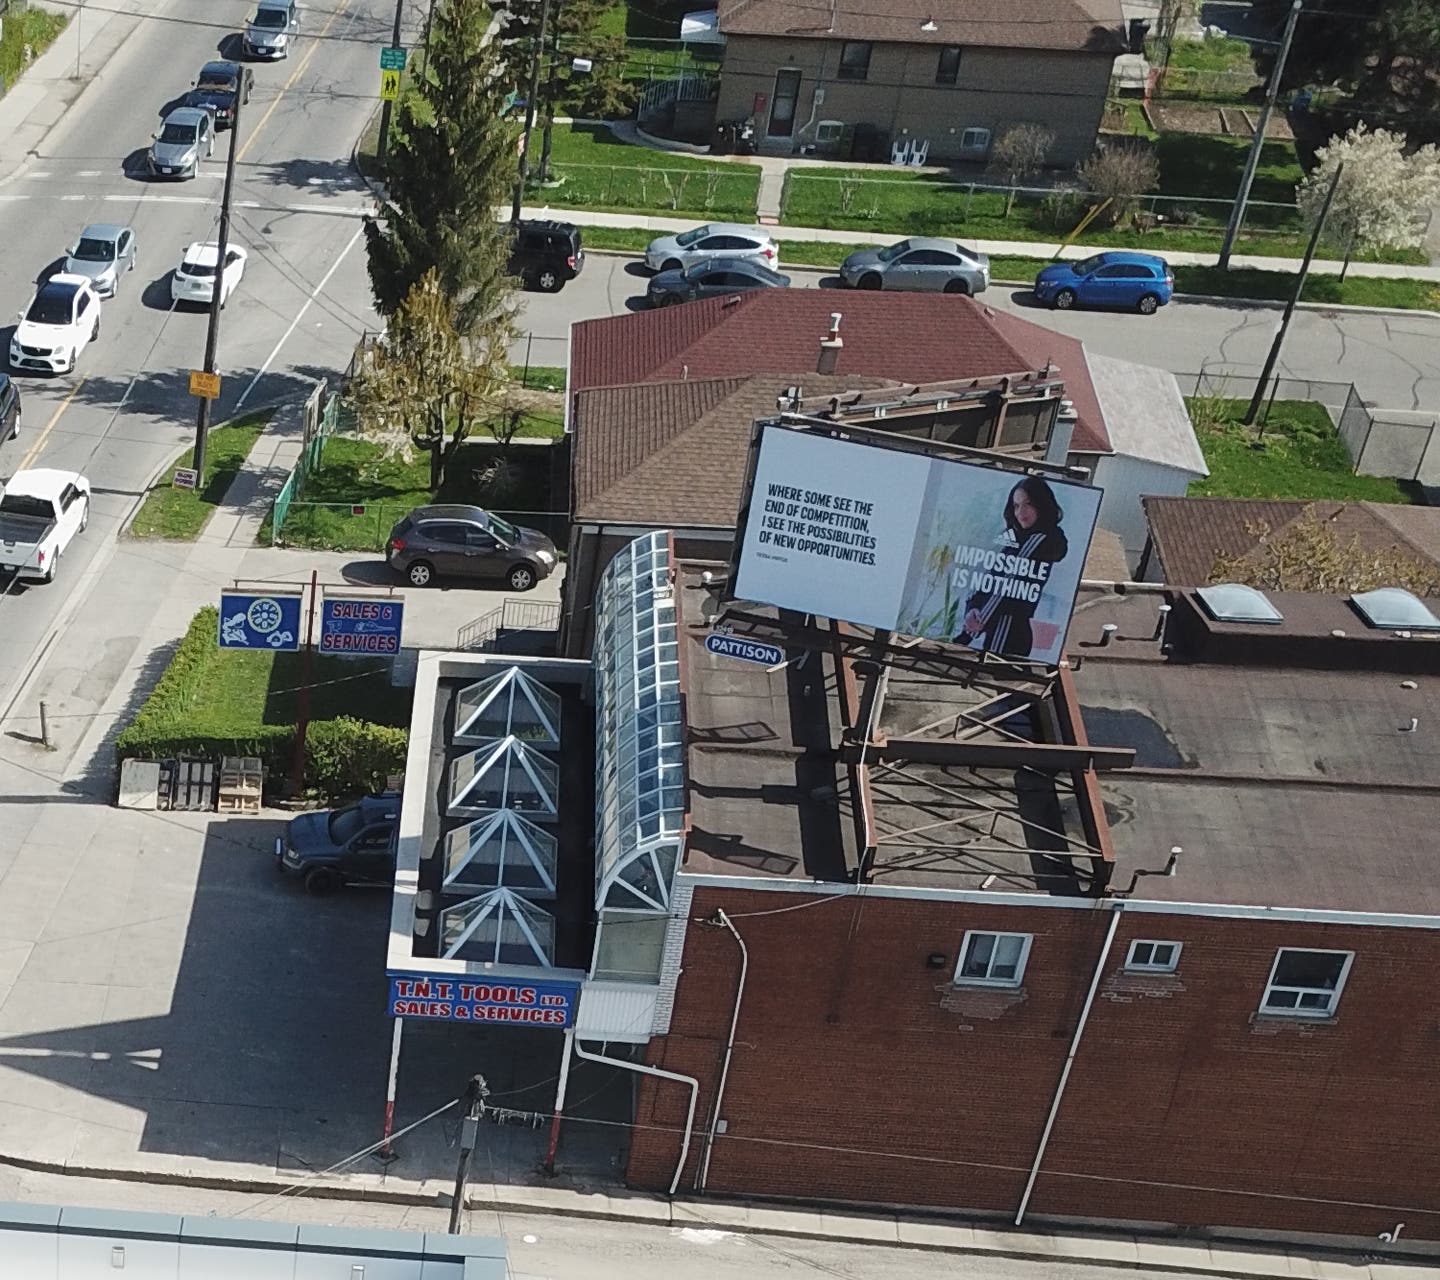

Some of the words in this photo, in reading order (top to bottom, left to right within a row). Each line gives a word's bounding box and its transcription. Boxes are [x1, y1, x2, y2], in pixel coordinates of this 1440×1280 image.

[768, 483, 803, 501] WHERE
[804, 490, 832, 508] SOME
[833, 496, 854, 512] SEE
[854, 500, 874, 516] THE
[761, 515, 767, 527] I
[767, 516, 786, 531] SEE
[788, 519, 806, 536] THE
[807, 524, 877, 550] POSSIBILITIES
[764, 499, 785, 514] END
[786, 503, 800, 517] OF
[800, 506, 870, 534] COMPETITION,
[759, 530, 773, 544] OF
[772, 533, 797, 549] NEW
[797, 538, 877, 567] OPPORTUNITIES.
[954, 544, 1050, 581] IMPOSSIBLE
[952, 567, 969, 588] IS
[969, 571, 1041, 603] NOTHING
[332, 602, 380, 619] SALES
[382, 606, 393, 619] &
[323, 633, 397, 652] SERVICES
[711, 638, 777, 662] PATTISON
[396, 980, 454, 1000] T.N.T.
[459, 984, 536, 1005] TOOLS
[540, 995, 569, 1006] LTD.
[394, 1000, 452, 1017] SALES
[455, 1006, 470, 1019] &
[473, 1005, 567, 1024] SERVICES
